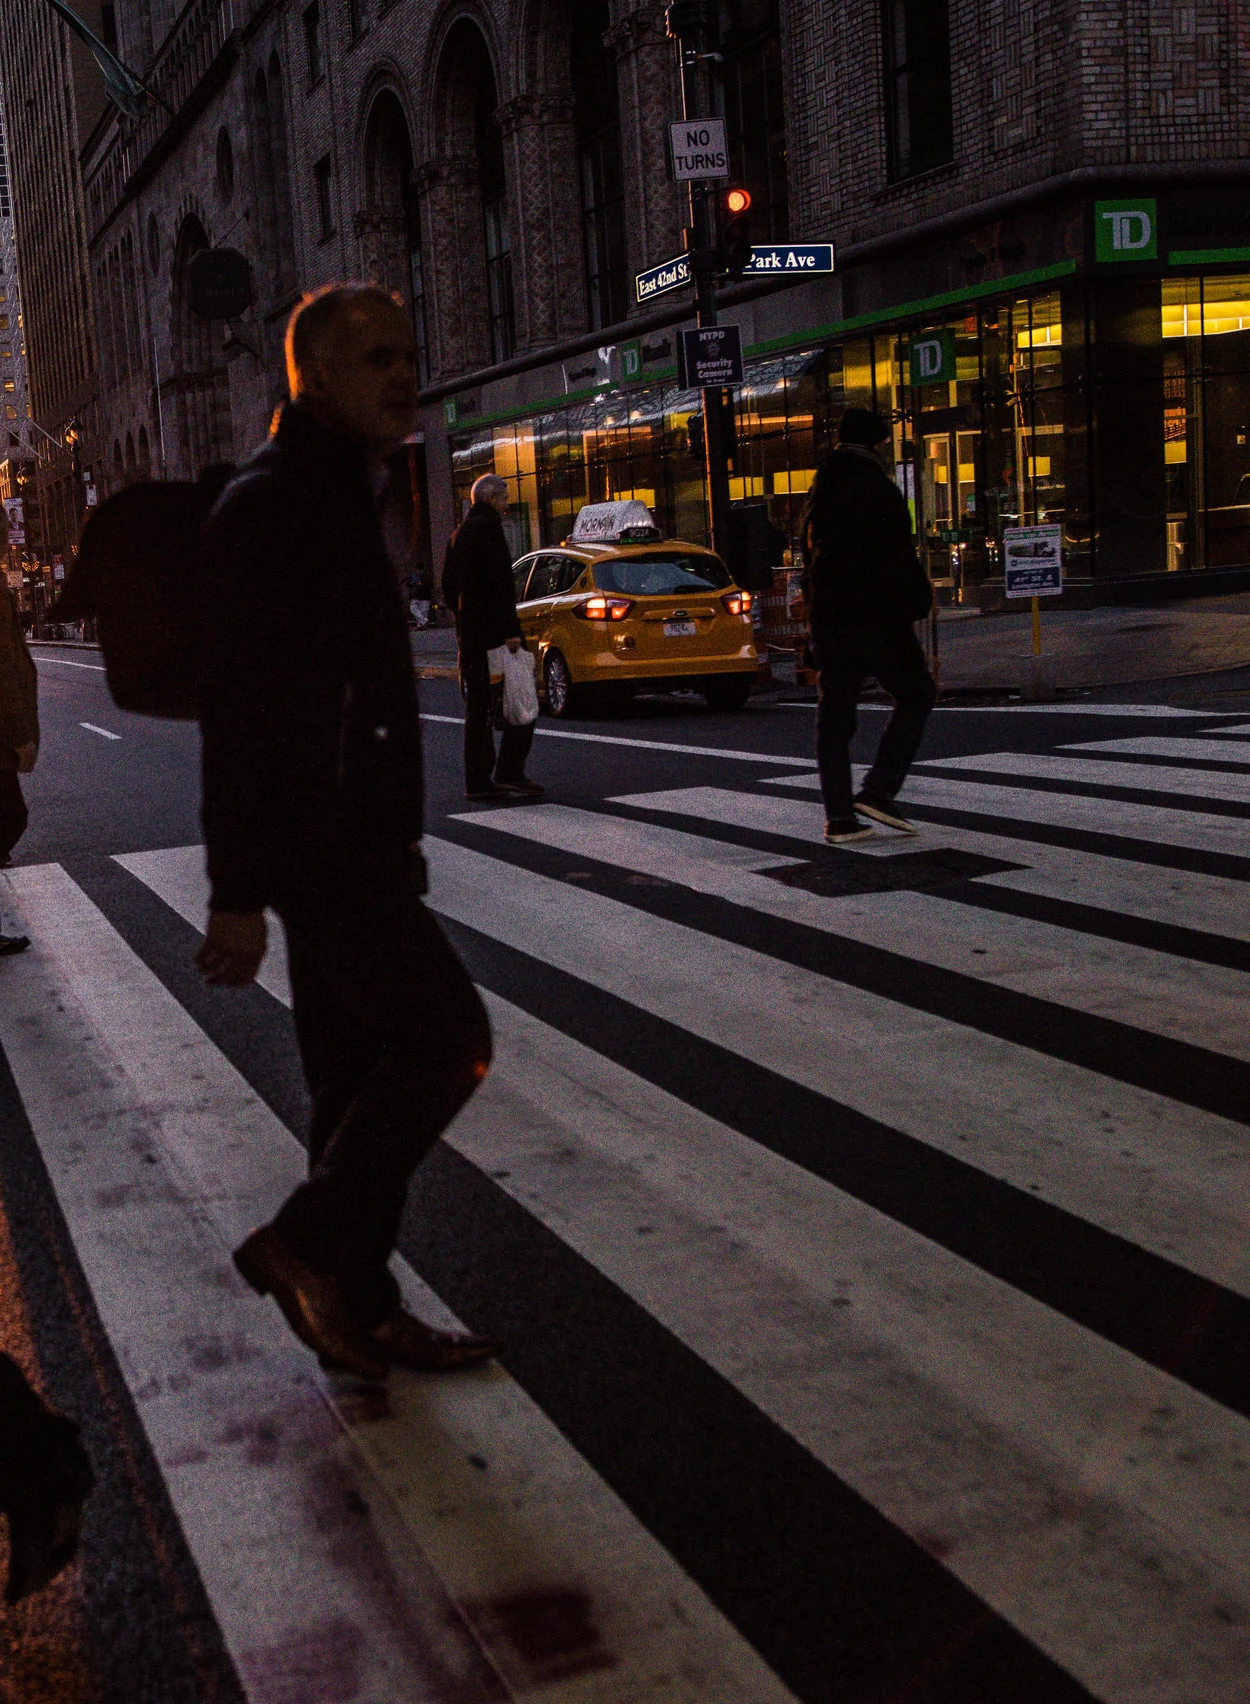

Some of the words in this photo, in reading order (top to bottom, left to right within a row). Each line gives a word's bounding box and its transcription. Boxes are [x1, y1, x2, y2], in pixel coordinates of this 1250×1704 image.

[686, 129, 710, 147] NO
[675, 152, 726, 171] TURNS
[1102, 211, 1151, 250] TD
[784, 251, 817, 269] Ave
[638, 277, 657, 297] East
[657, 265, 678, 287] 42nd
[677, 261, 688, 278] St
[698, 330, 725, 342] NYPD
[695, 358, 733, 370] Security
[913, 339, 943, 378] TD
[697, 369, 733, 379] Camera
